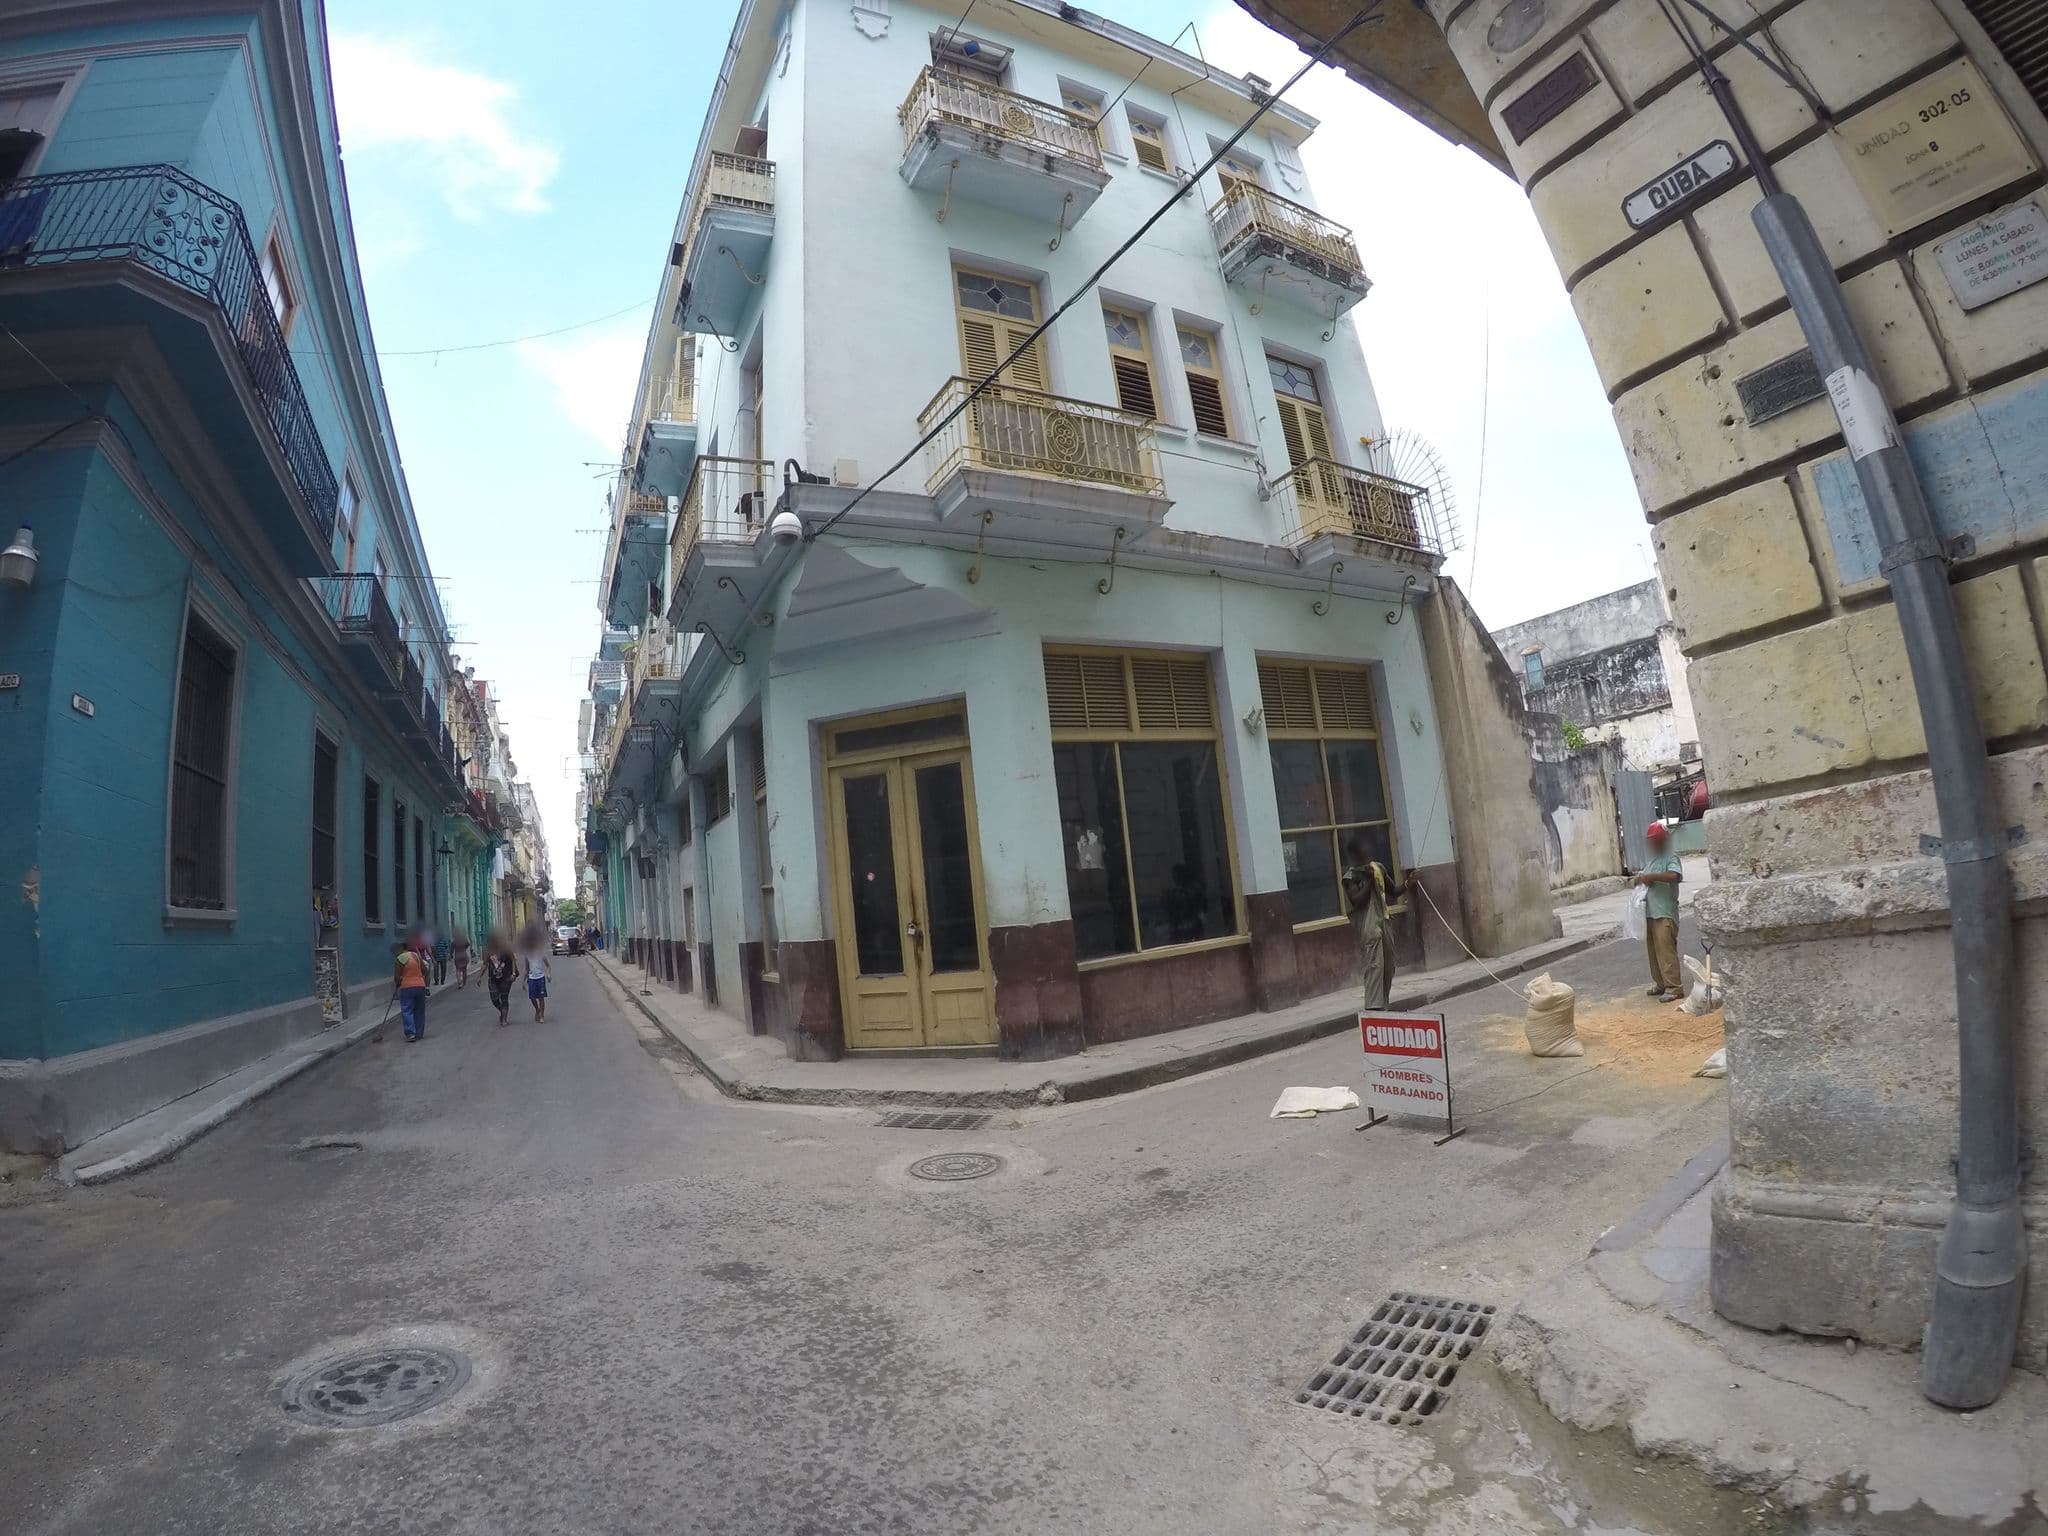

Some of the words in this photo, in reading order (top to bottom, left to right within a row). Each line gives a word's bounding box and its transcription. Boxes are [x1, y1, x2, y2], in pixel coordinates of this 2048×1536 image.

[1855, 121, 1911, 157] UNIDAD
[1929, 140, 1939, 153] 8
[1647, 160, 1711, 211] CUBA
[1955, 243, 1989, 264] LUNES
[1992, 239, 2000, 249] A
[2000, 223, 2035, 245] SABADO
[1960, 222, 2006, 249] HORARIO
[1366, 1025, 1438, 1050] CUIDADO
[1379, 1068, 1433, 1084] HOMBRES
[1371, 1083, 1444, 1102] TRABAJANDO
